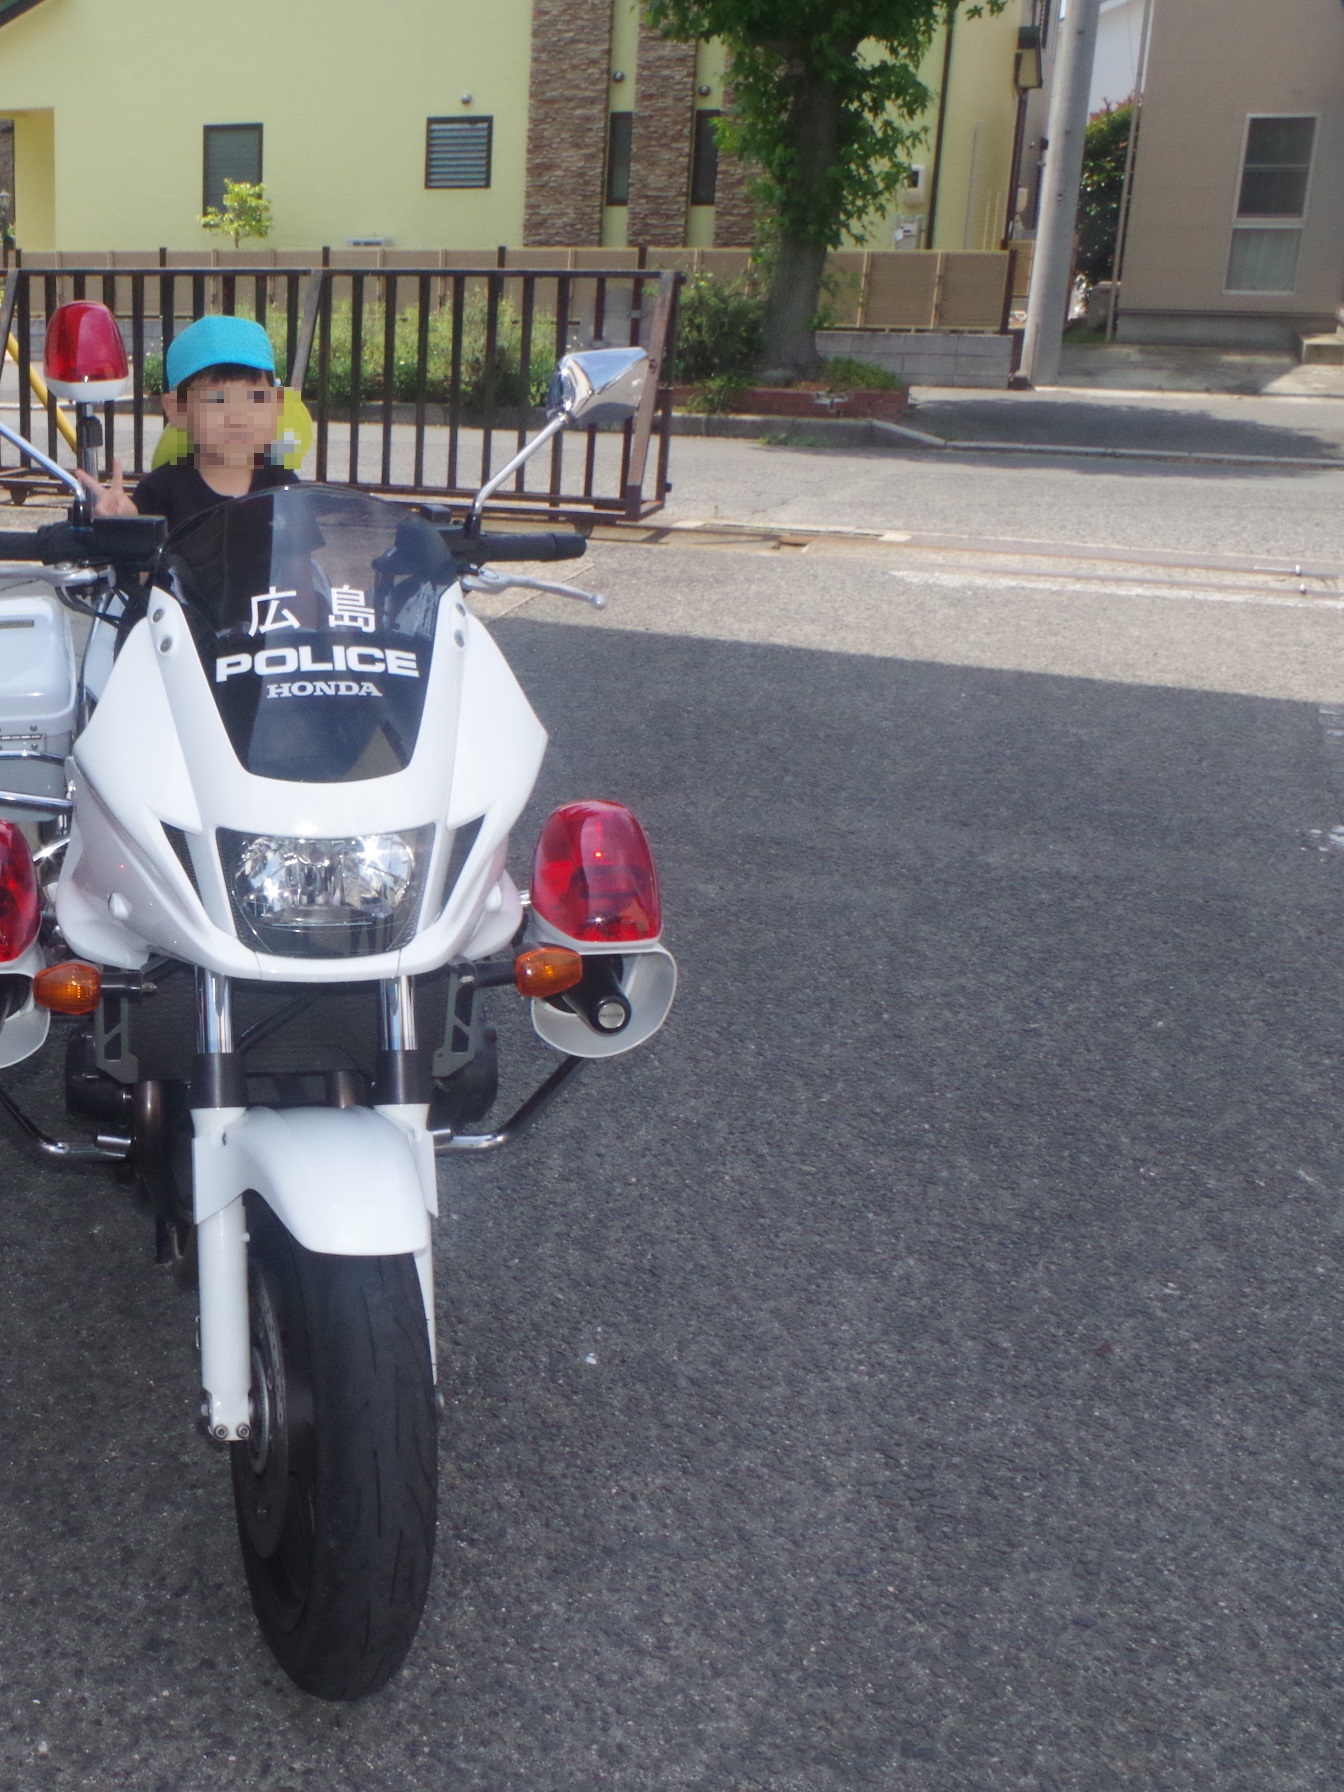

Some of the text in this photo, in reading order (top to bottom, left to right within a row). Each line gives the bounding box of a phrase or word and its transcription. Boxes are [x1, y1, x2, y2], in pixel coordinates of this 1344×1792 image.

[248, 584, 376, 637] 広島
[216, 645, 419, 682] POLICE
[266, 681, 383, 698] HONDA
